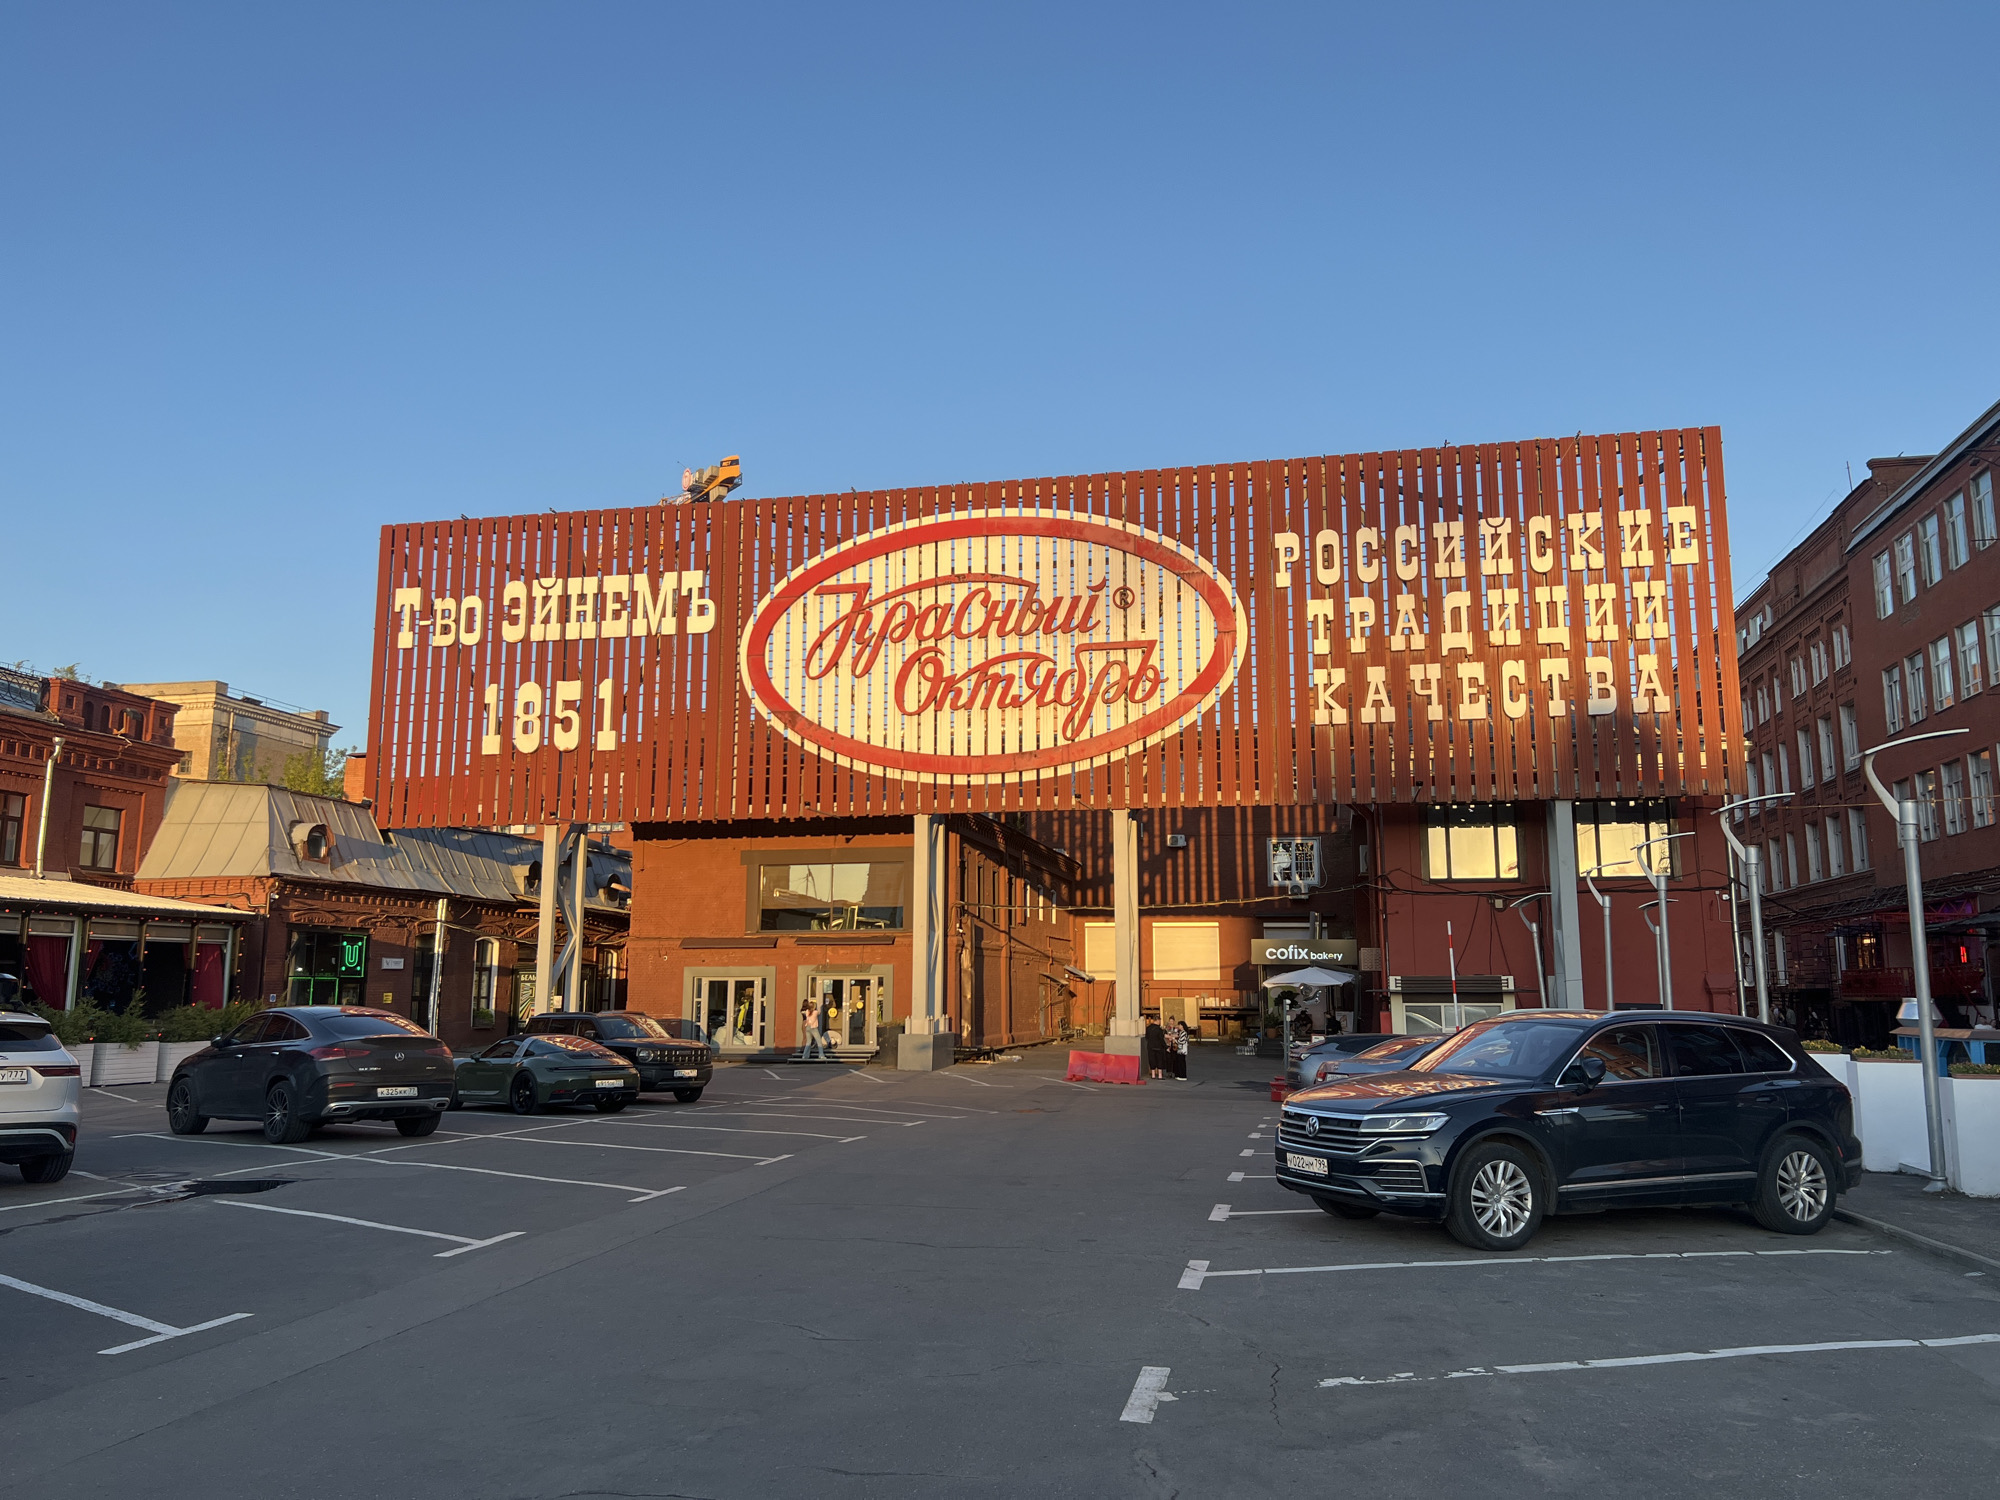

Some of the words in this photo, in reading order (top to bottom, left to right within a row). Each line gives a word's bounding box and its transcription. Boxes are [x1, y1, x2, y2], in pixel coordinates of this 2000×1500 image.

[1274, 505, 1699, 588] РОССИЙСКИЕ
[501, 570, 716, 644] ЭЙНЕМЪ
[805, 573, 1106, 680] Красный
[1307, 580, 1669, 656] ТРАДИЦИИ
[481, 678, 618, 755] 1851
[894, 639, 1169, 741] Октябрь
[1313, 654, 1671, 725] КАЧЕСТВА
[1265, 944, 1309, 960] cofix
[1310, 951, 1343, 961] bakery
